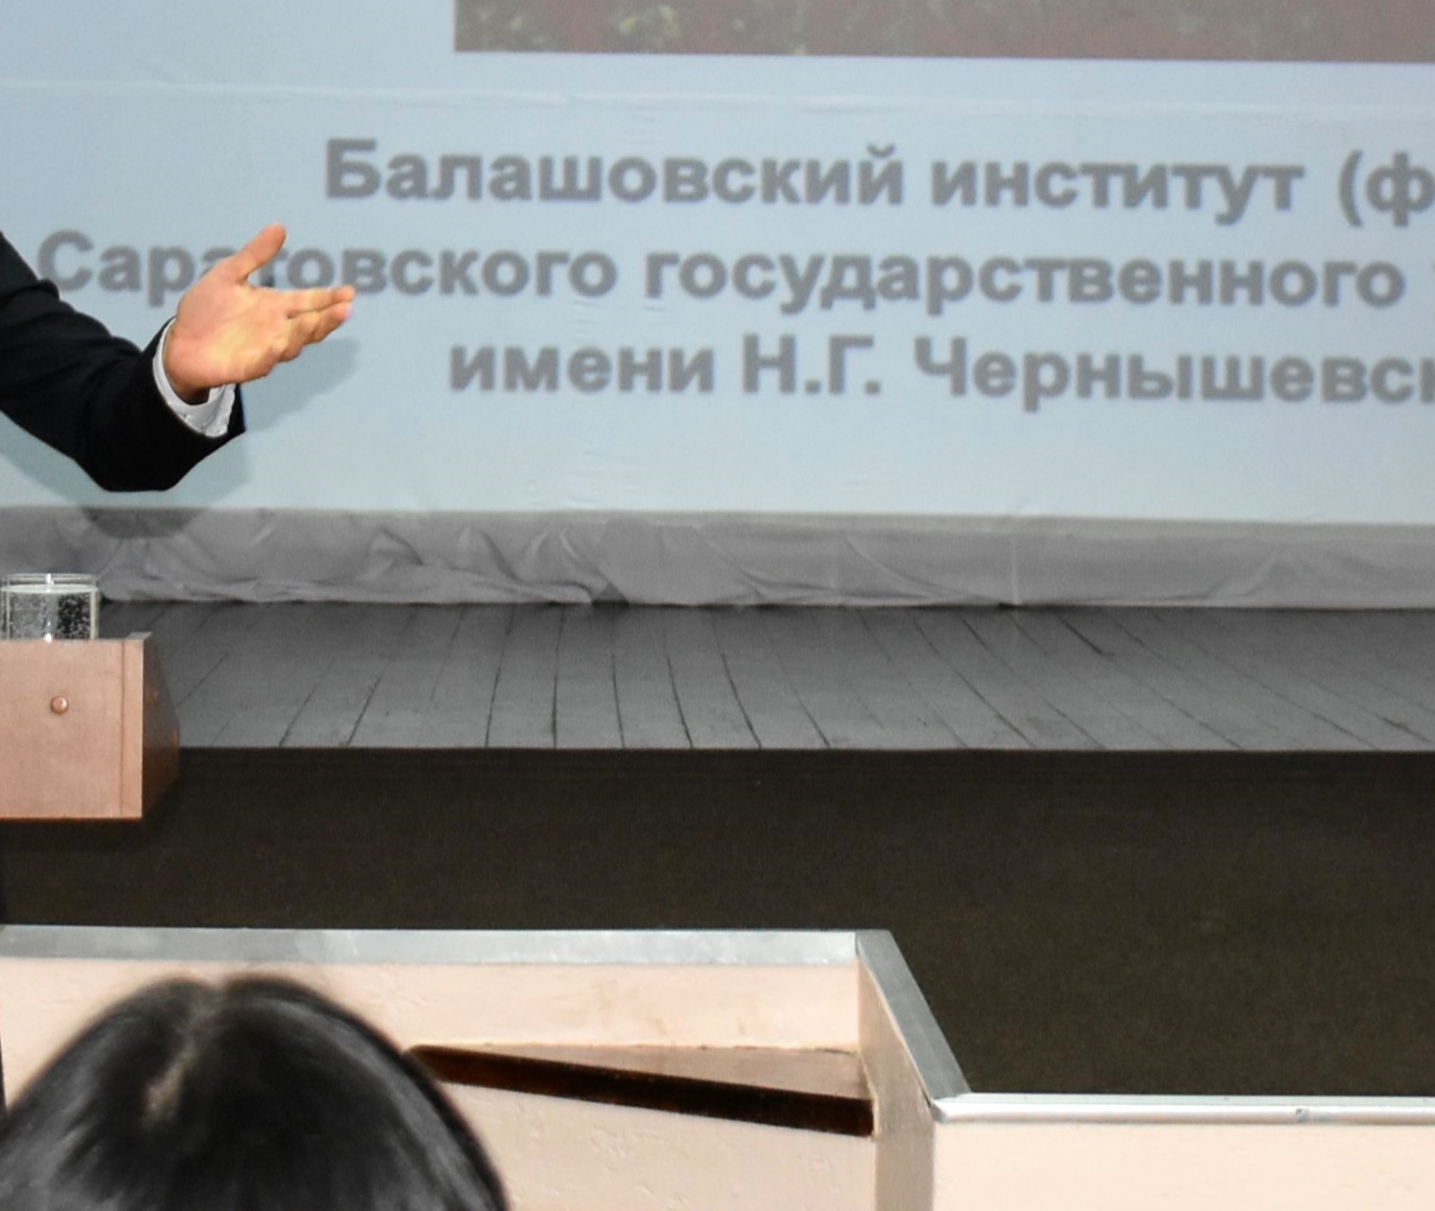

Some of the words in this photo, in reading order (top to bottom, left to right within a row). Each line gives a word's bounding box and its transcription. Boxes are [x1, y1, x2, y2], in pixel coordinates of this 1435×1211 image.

[326, 138, 904, 206] Балашовский
[931, 161, 1306, 226] институт
[645, 252, 1406, 317] государственного
[449, 346, 715, 394] имени
[743, 334, 881, 396] Н.Г.
